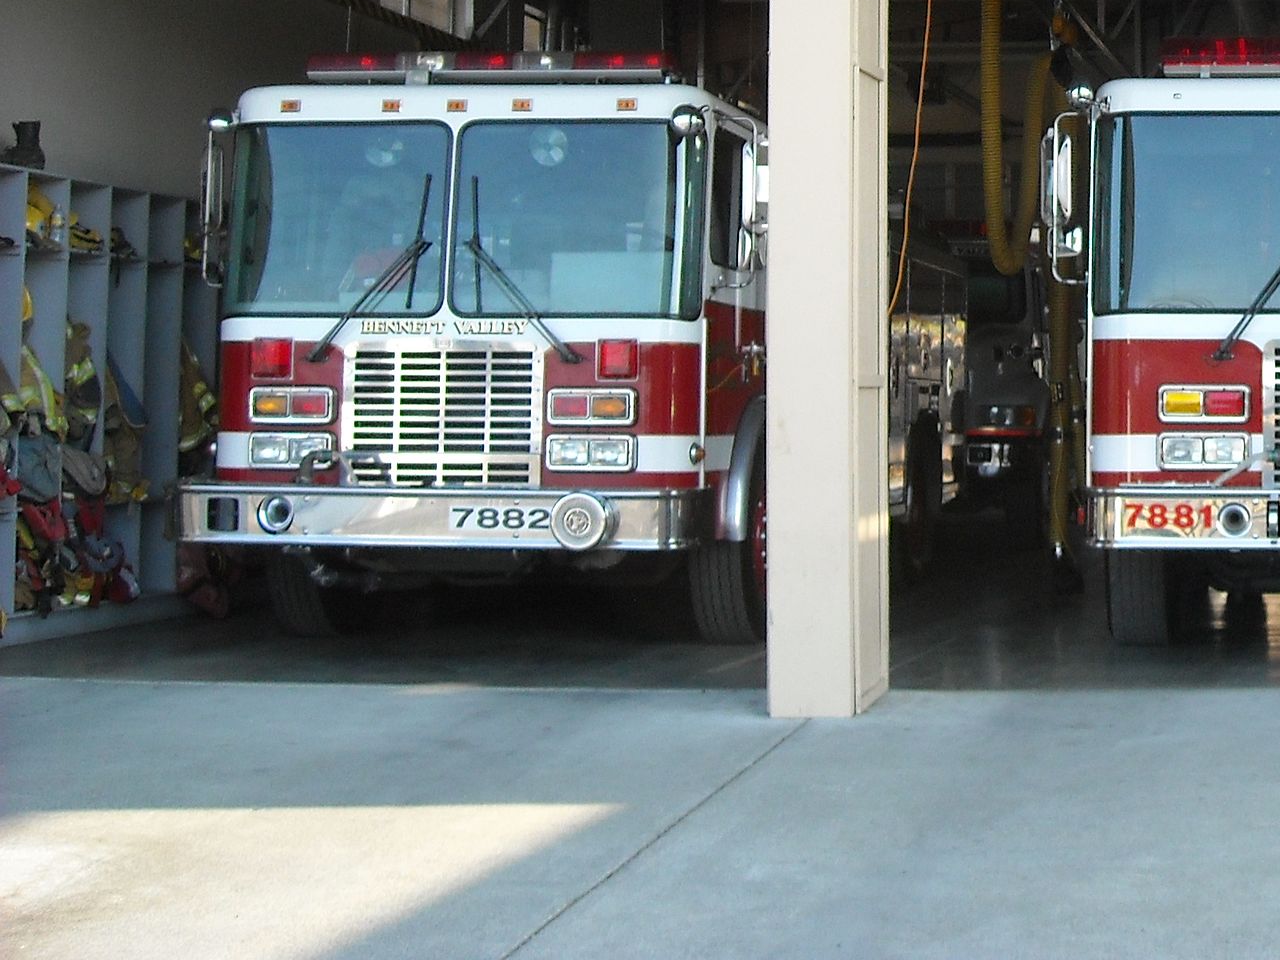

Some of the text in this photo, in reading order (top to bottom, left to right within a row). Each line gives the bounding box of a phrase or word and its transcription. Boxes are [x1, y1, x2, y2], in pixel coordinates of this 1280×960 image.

[361, 319, 529, 336] BENNETT VALLEY
[452, 507, 550, 530] 7882
[1124, 504, 1213, 529] 7881
